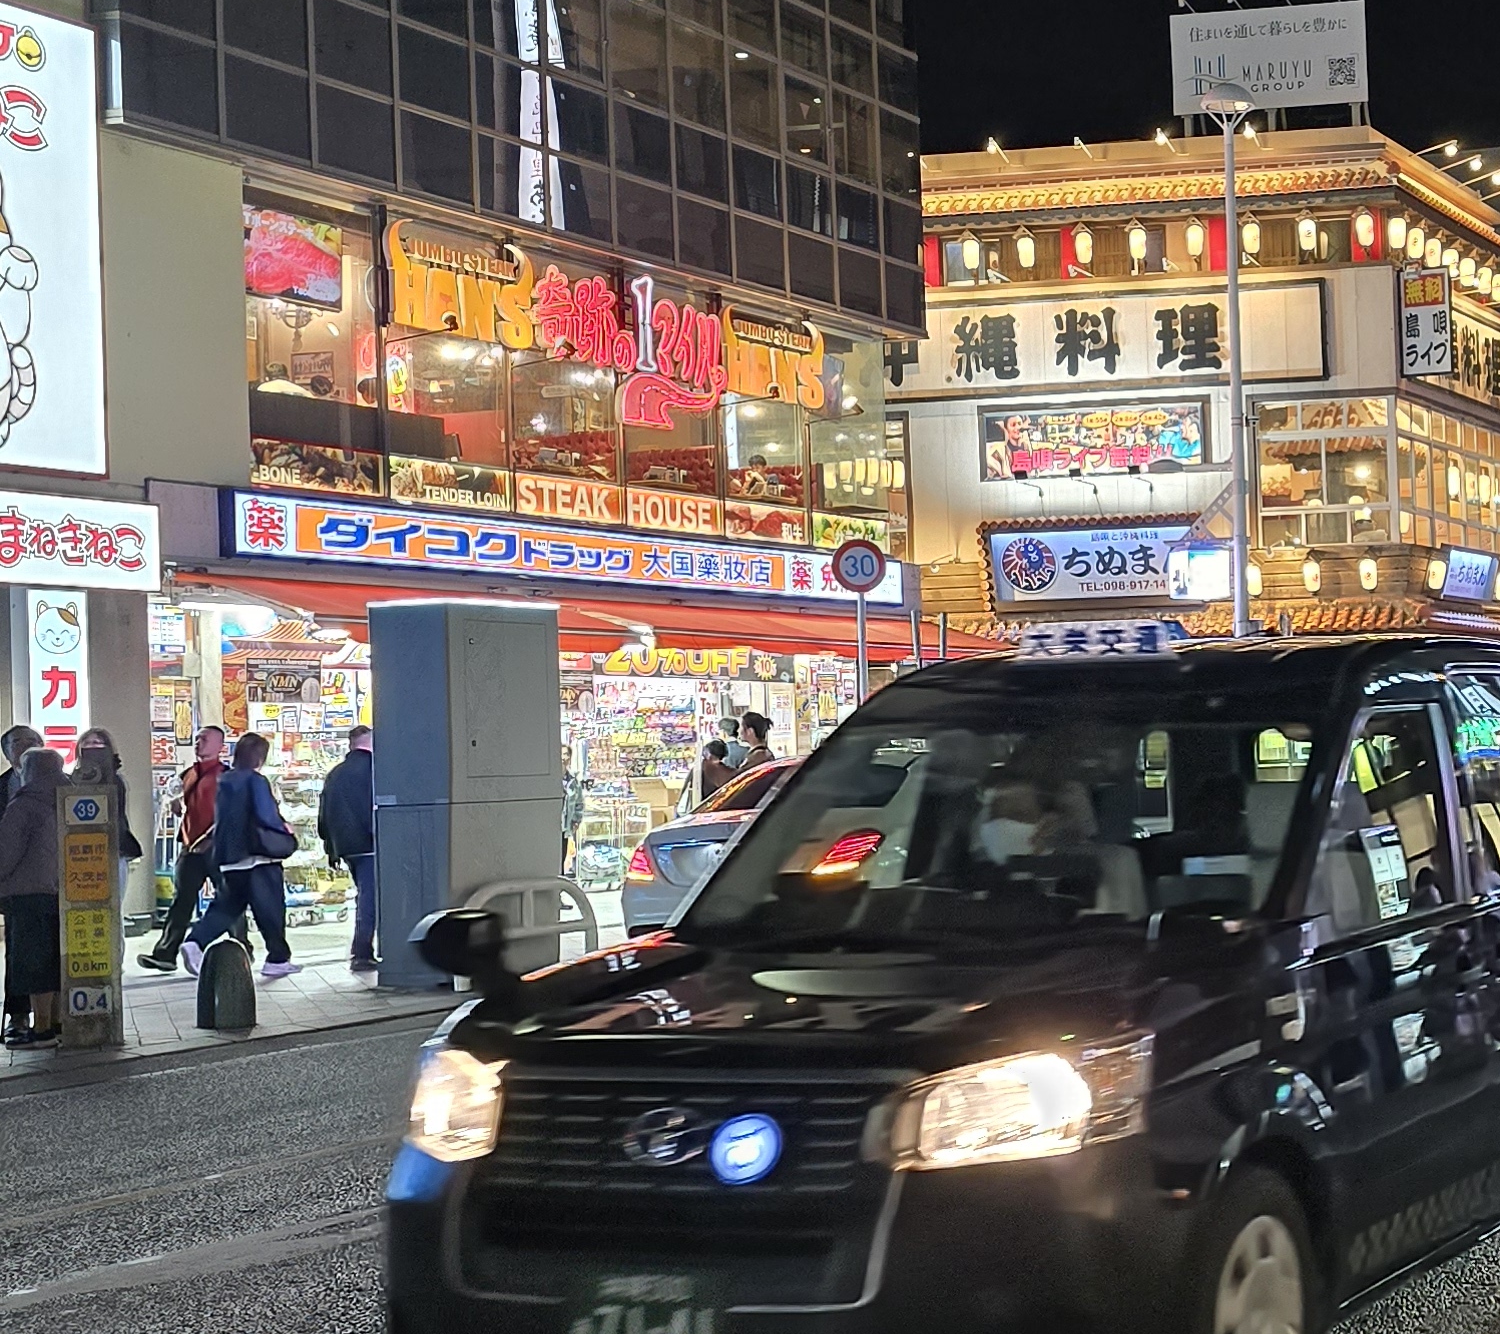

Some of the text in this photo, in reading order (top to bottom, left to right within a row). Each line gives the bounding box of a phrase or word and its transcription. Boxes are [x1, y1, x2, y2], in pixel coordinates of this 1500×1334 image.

[1189, 17, 1348, 43] 住まいを通して暮らしを豊かに
[1242, 59, 1313, 83] MARUYU
[1250, 80, 1306, 93] GROUP
[1406, 276, 1443, 304] 無料
[1405, 310, 1448, 338] 島唄
[1405, 339, 1449, 367] ライブ
[422, 485, 506, 509] TENDER LOIN
[518, 478, 713, 532] STEAK HOUSE
[0, 508, 145, 569] まねきねこ
[246, 498, 286, 549] 薬
[318, 513, 633, 571] ダイコクドラッグ
[844, 554, 875, 578] 30
[1061, 543, 1169, 577] ちぬま
[1079, 579, 1167, 592] TEL:098-917-14
[269, 675, 299, 689] NMN
[700, 697, 717, 715] Tax
[77, 802, 97, 817] 39
[72, 990, 108, 1011] 0.4
